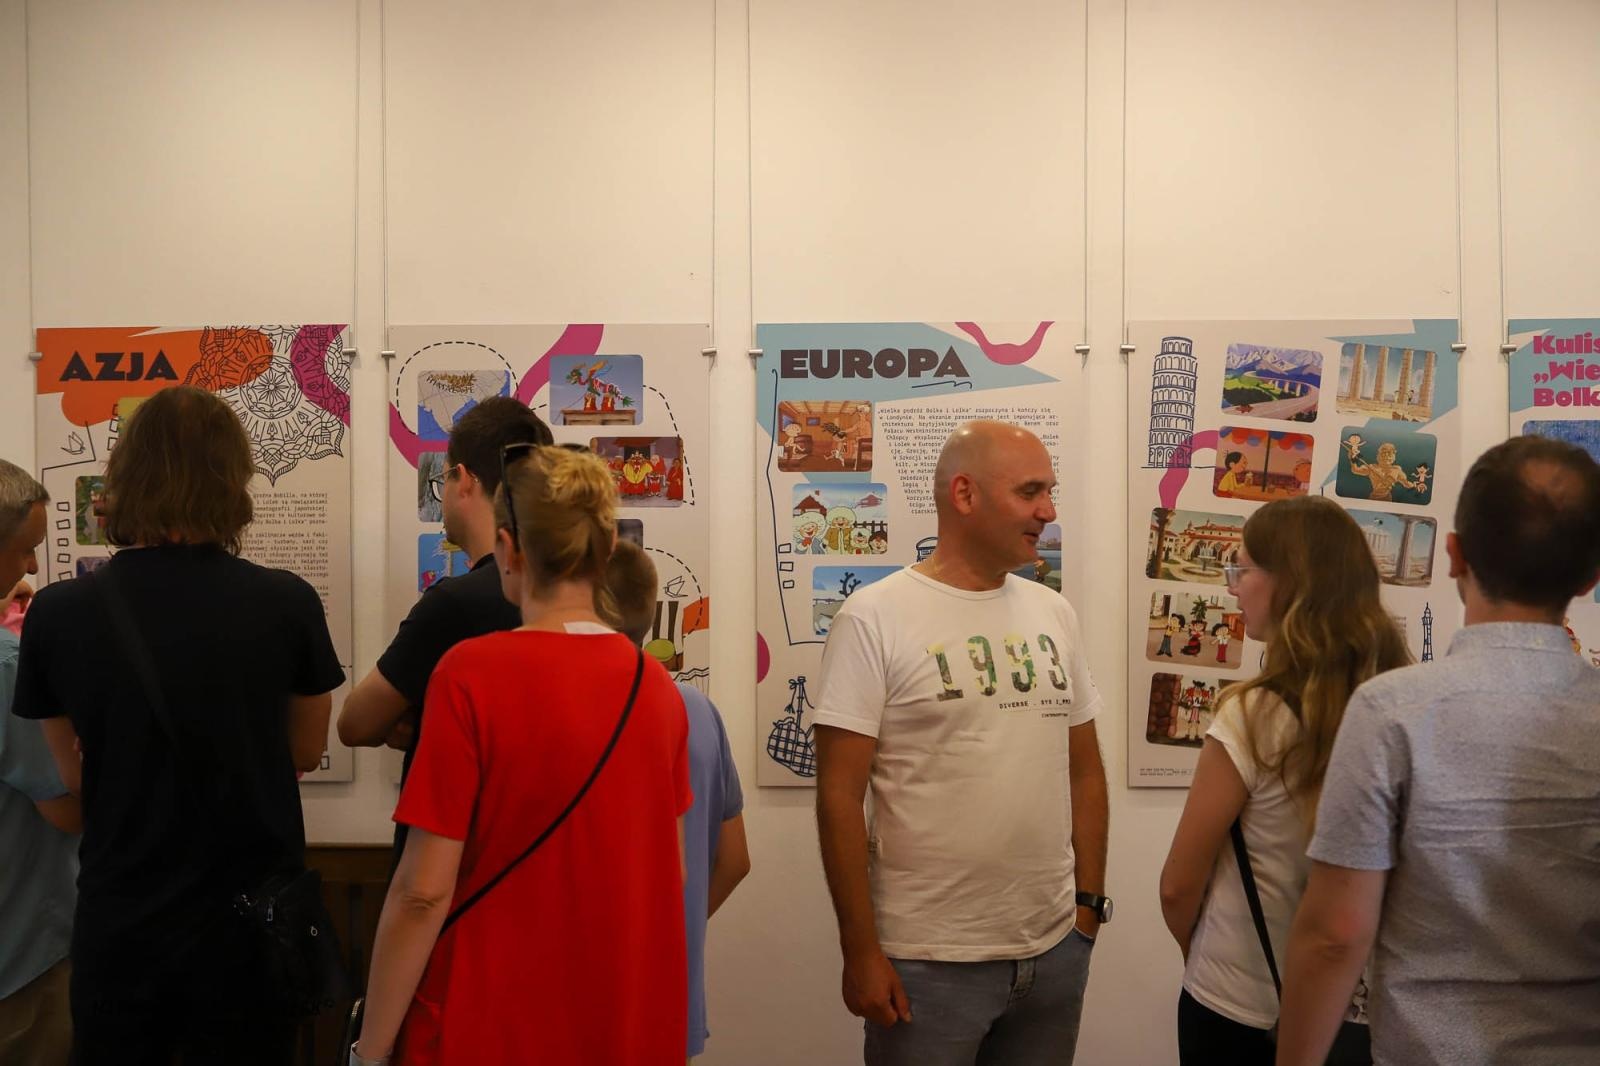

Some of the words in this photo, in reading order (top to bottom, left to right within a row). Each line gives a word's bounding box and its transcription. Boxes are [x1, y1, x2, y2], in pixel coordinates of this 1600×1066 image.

[59, 350, 179, 381] AZJA
[781, 345, 970, 379] EUROPA
[927, 633, 1067, 701] 1993
[999, 701, 1029, 709] DIVERSE
